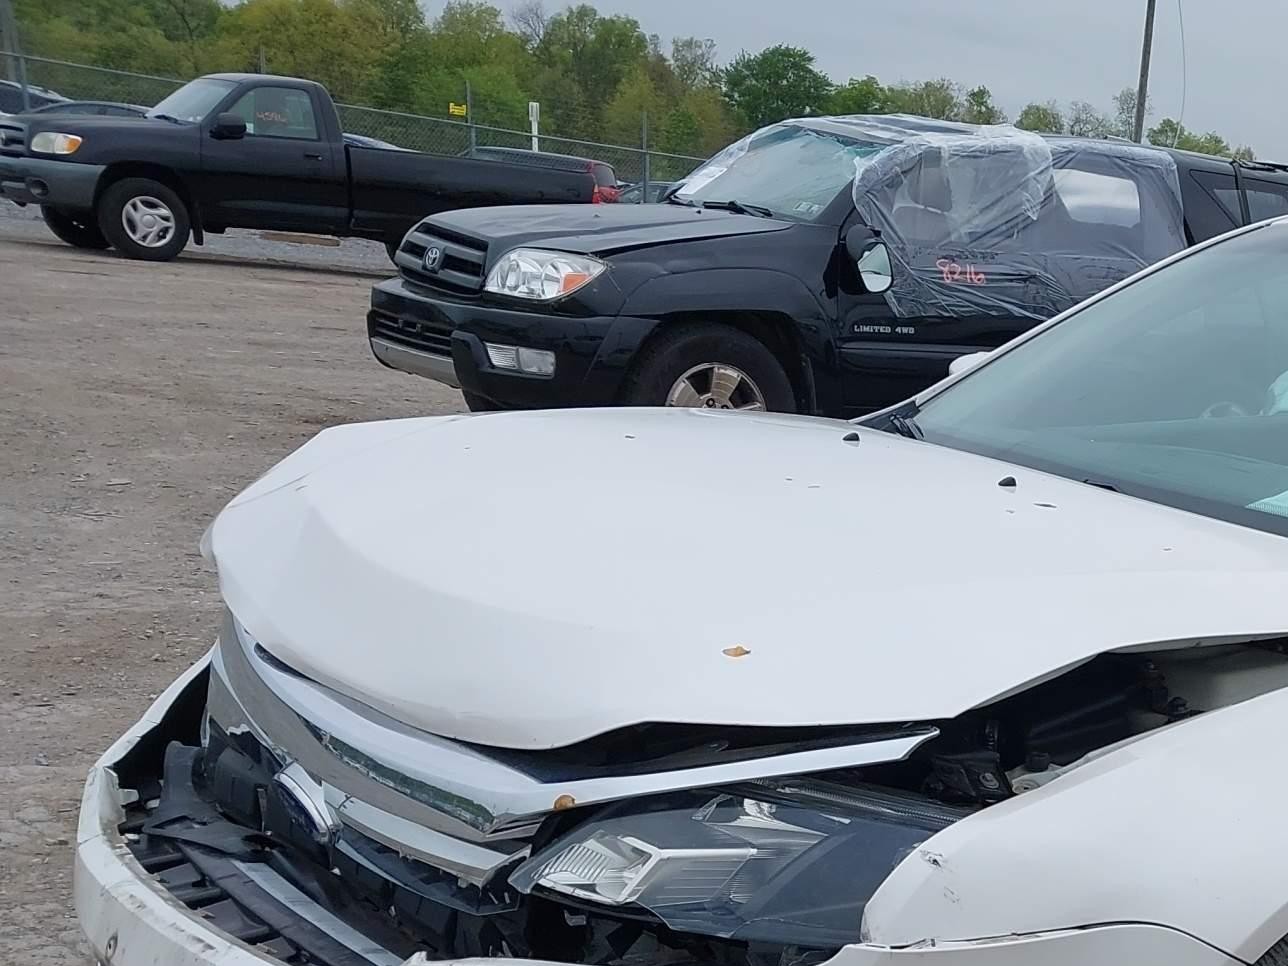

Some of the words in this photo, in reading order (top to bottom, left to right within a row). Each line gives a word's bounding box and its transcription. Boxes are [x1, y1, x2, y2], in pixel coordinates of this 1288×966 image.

[936, 259, 985, 285] 8216
[854, 324, 891, 334] LIMITED
[895, 326, 915, 334] 4WD
